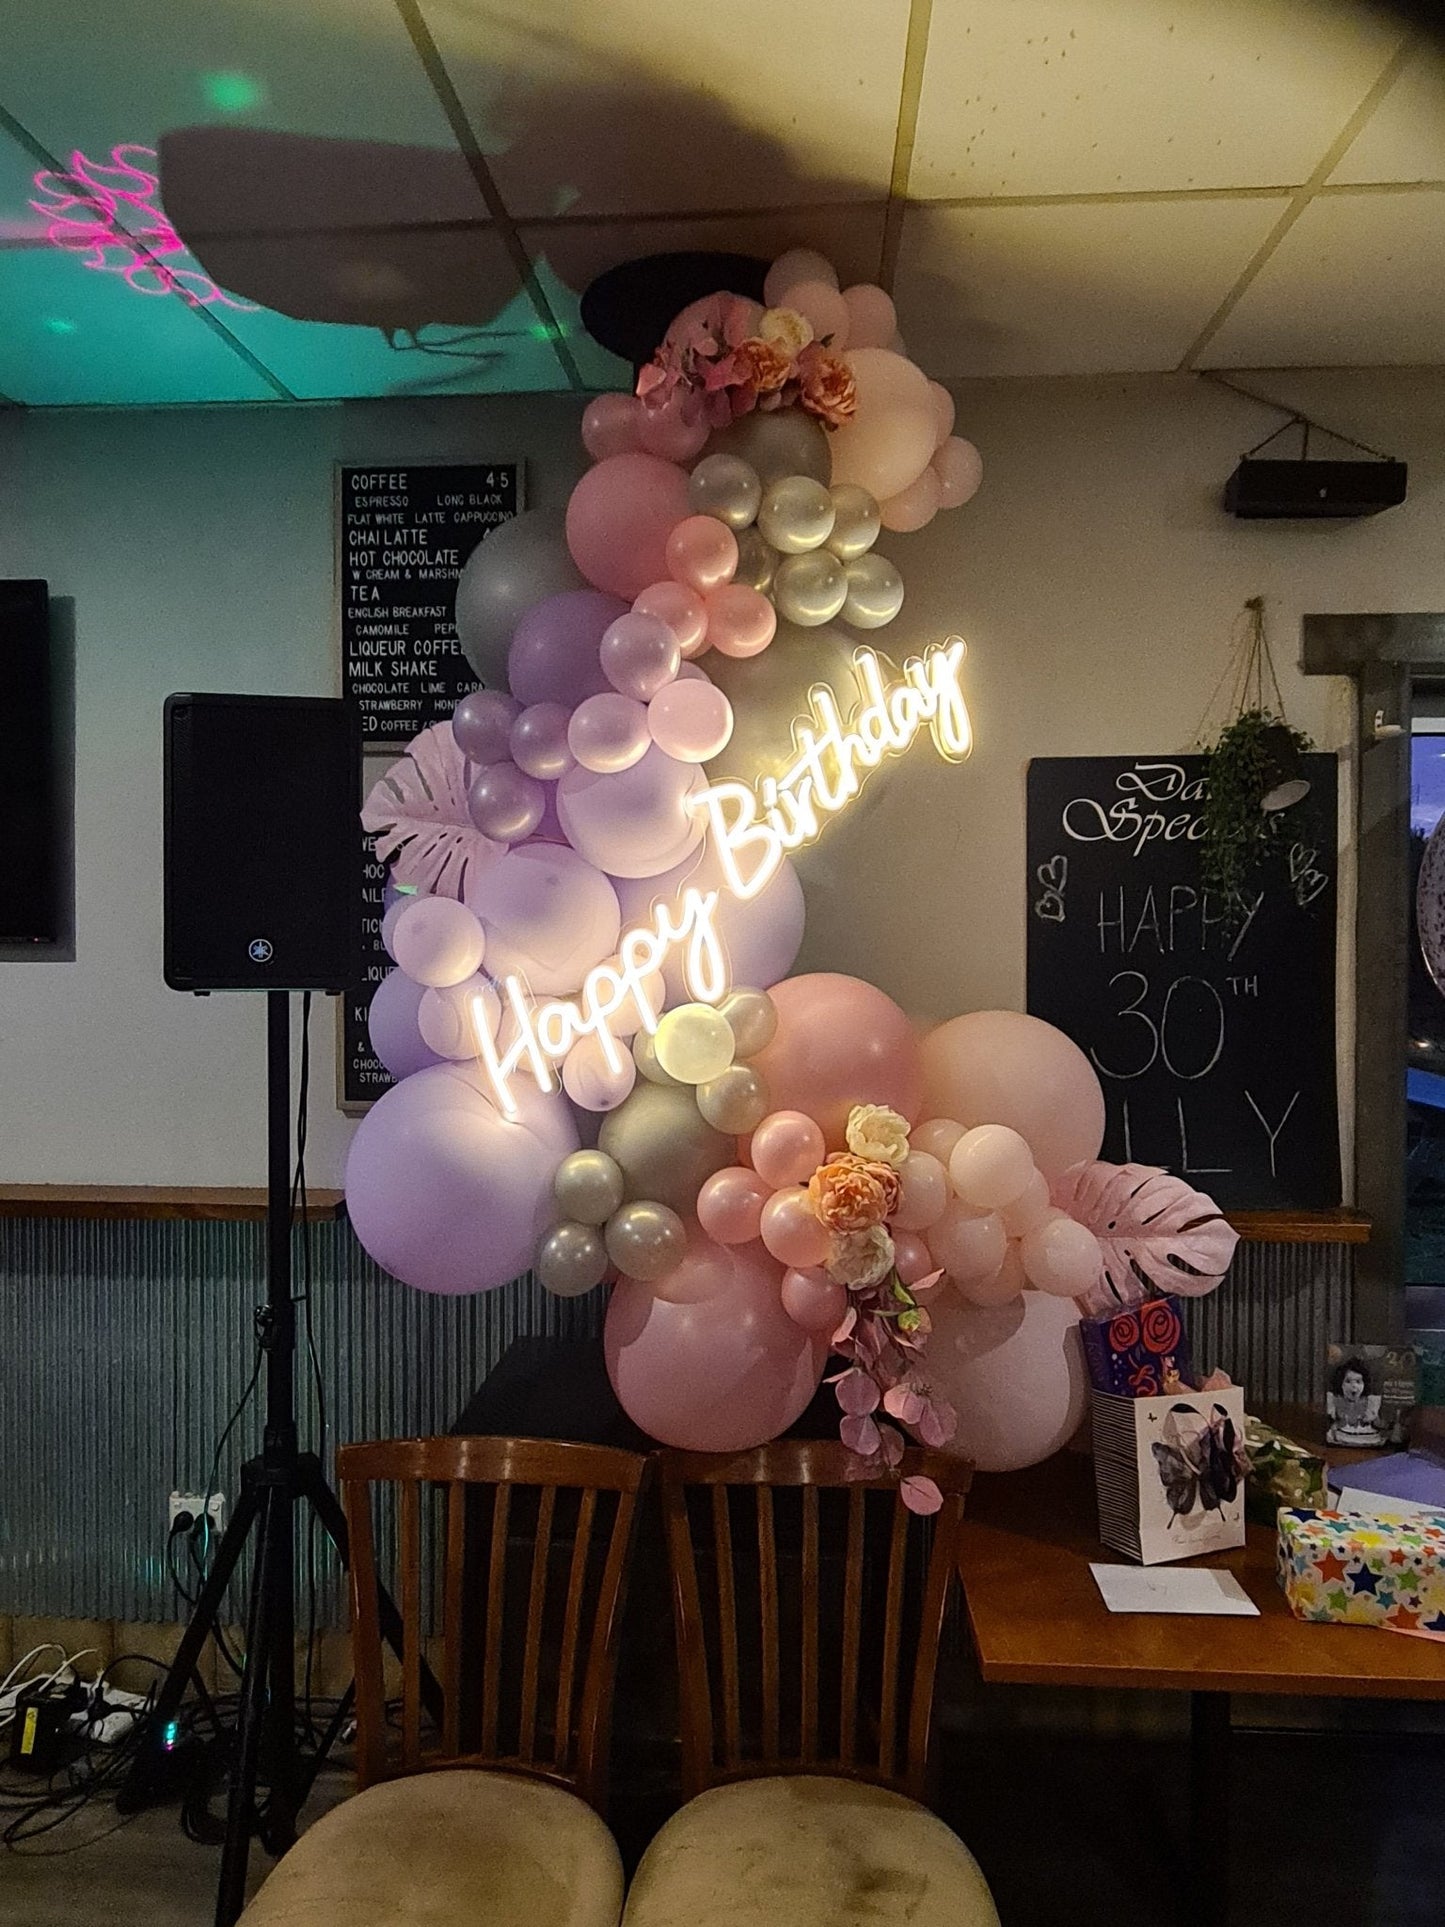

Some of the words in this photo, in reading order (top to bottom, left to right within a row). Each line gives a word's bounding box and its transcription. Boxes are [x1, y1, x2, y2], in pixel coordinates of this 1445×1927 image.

[352, 473, 408, 491] COFFEE
[354, 495, 409, 508] ESPRESSO
[437, 494, 465, 506] LONG
[468, 494, 503, 506] BLACK
[347, 513, 371, 525] FLAT
[375, 512, 405, 525] WHITE
[415, 511, 446, 524] LATTE
[453, 510, 514, 523] CAPPUCCINO
[349, 530, 380, 546] CHAI
[384, 528, 428, 546] LATTE
[349, 551, 376, 567] HOT
[382, 549, 459, 566] CHOCOLATE
[365, 568, 400, 580] CREAM
[404, 568, 412, 579] &
[350, 585, 380, 601] TEA
[347, 606, 389, 619] ENGLISH
[392, 605, 447, 618] BREAKFAST
[355, 622, 410, 636] CAMOMILE
[349, 639, 406, 656] LIQUEUR
[349, 661, 384, 677] MILK
[391, 660, 438, 677] SHAKE
[352, 681, 411, 694] CHOCOLATE
[420, 681, 446, 694] LIME
[358, 698, 423, 711] STRAWBERRY
[380, 719, 418, 732] COFFEE
[472, 887, 729, 1113] Happy
[690, 639, 968, 899] Birthday
